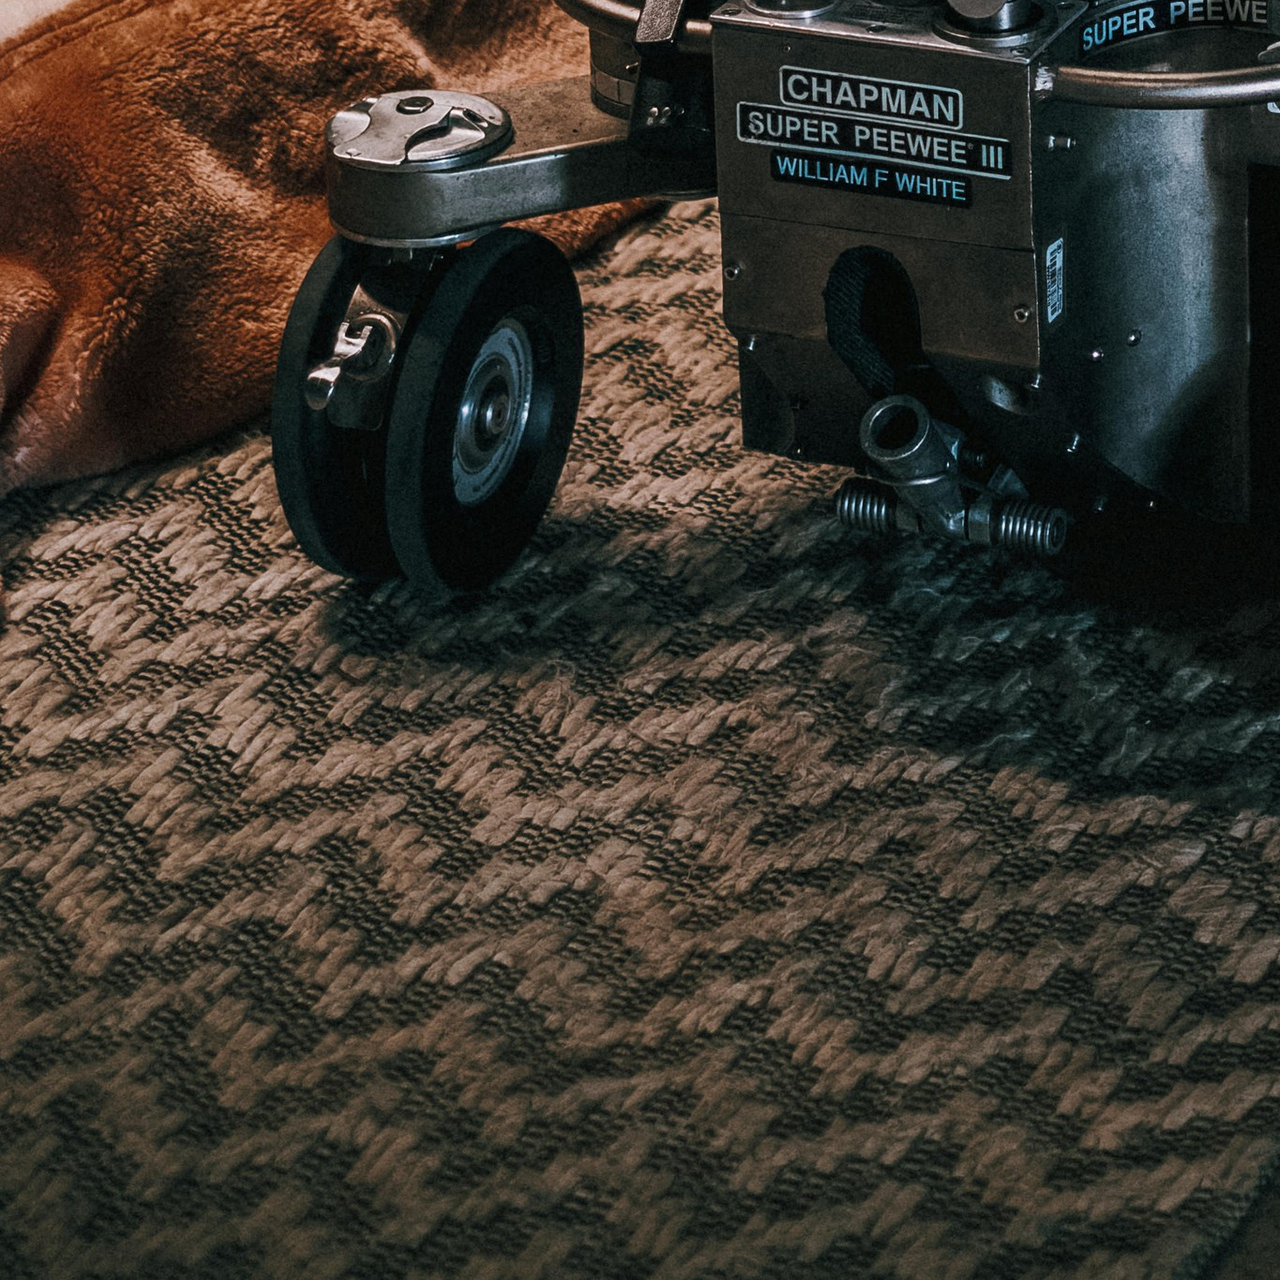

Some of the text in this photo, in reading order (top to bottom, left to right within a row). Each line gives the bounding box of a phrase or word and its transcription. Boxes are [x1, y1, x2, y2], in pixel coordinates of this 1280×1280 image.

[1082, 6, 1155, 52] SUPER
[787, 74, 954, 122] CHAPMAN
[748, 110, 840, 145] SUPER
[854, 125, 968, 165] PEEWEE
[776, 155, 967, 201] WILLIAM F WHITE
